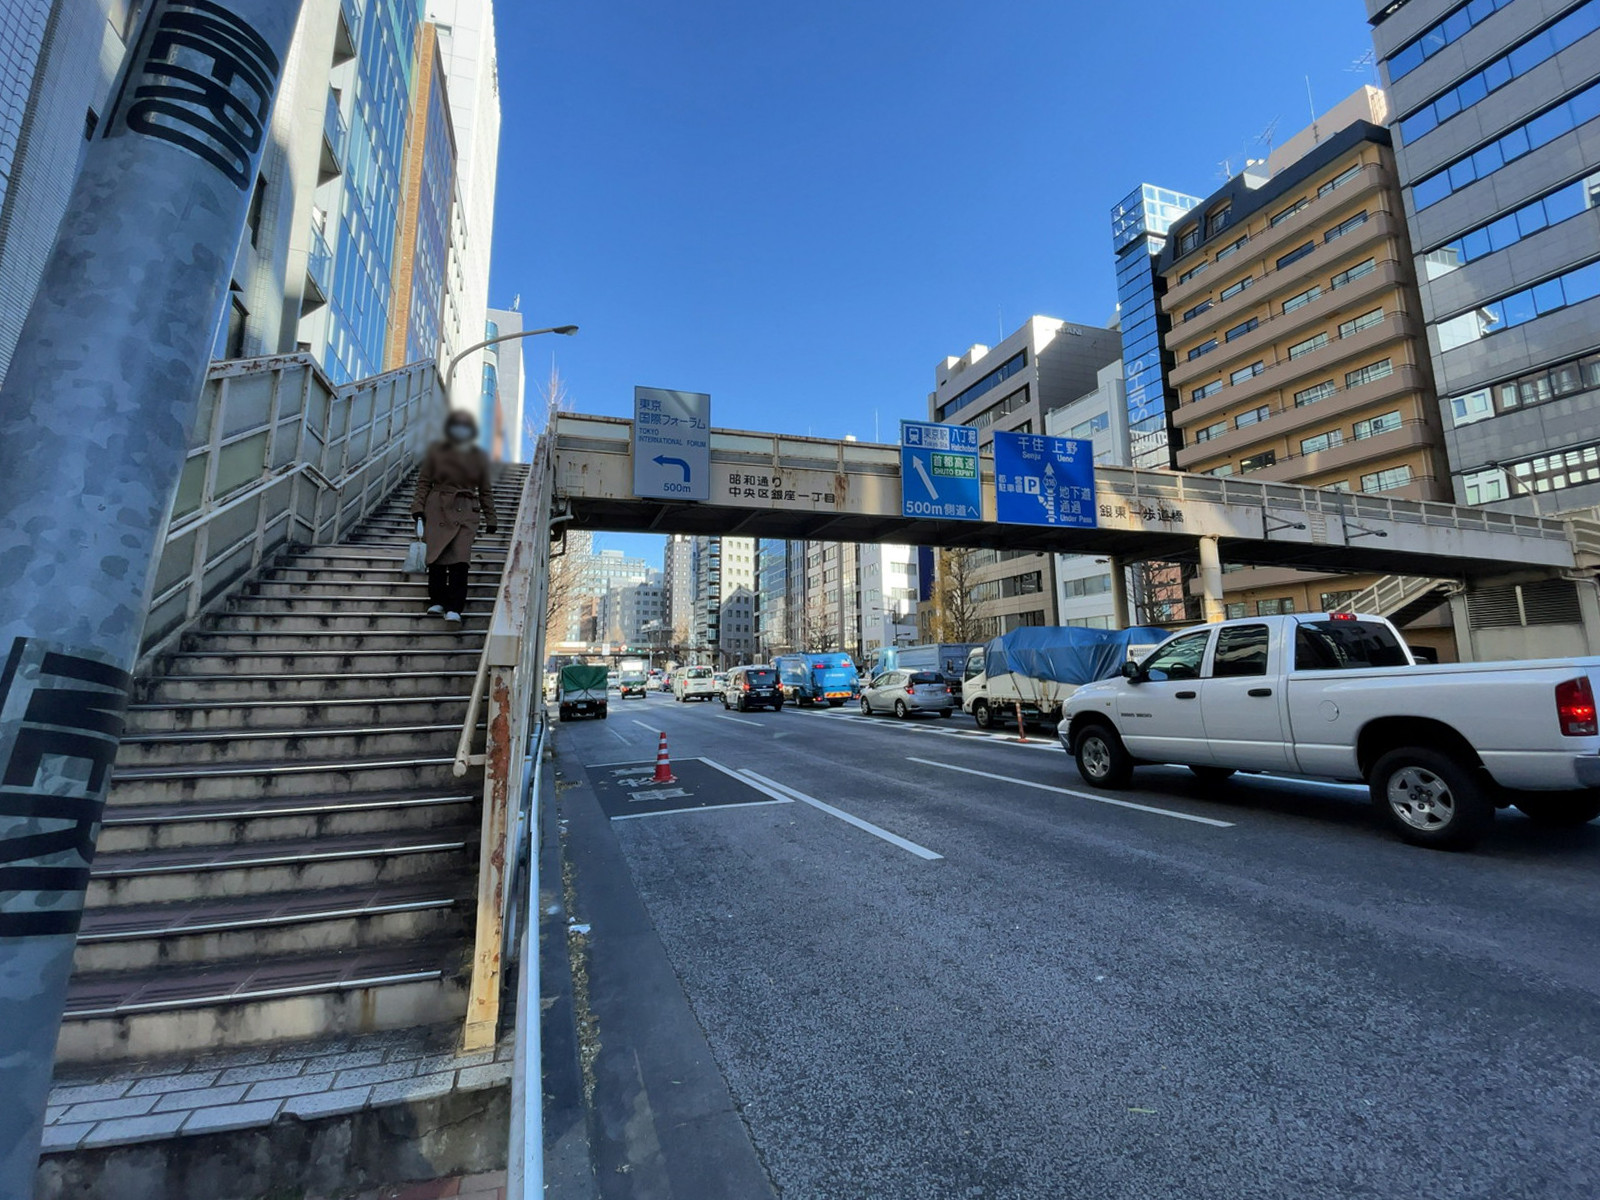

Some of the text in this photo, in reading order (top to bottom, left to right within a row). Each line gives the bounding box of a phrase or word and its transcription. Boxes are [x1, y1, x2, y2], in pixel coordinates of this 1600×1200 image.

[1127, 360, 1148, 423] SHIPS
[640, 398, 662, 412] 東京
[639, 412, 706, 430] 国際フォーラム
[639, 427, 659, 436] TOKYO
[923, 428, 977, 444] 東京駅 八丁堀
[639, 435, 706, 448] INTERNATIONAL FORUM
[1018, 436, 1078, 455] 千住 上野
[933, 455, 975, 470] 首都高速
[1022, 451, 1074, 463] Senju Ueno
[934, 467, 954, 475] SHUTO
[663, 483, 691, 493] 500m
[729, 473, 782, 488] 昭和通り
[729, 486, 835, 504] 中央区銀座一丁目
[1059, 485, 1091, 501] 地下道
[1060, 500, 1082, 514] 通過
[1099, 504, 1184, 523] 銀東一歩道橋
[1060, 514, 1093, 524] Under Pass
